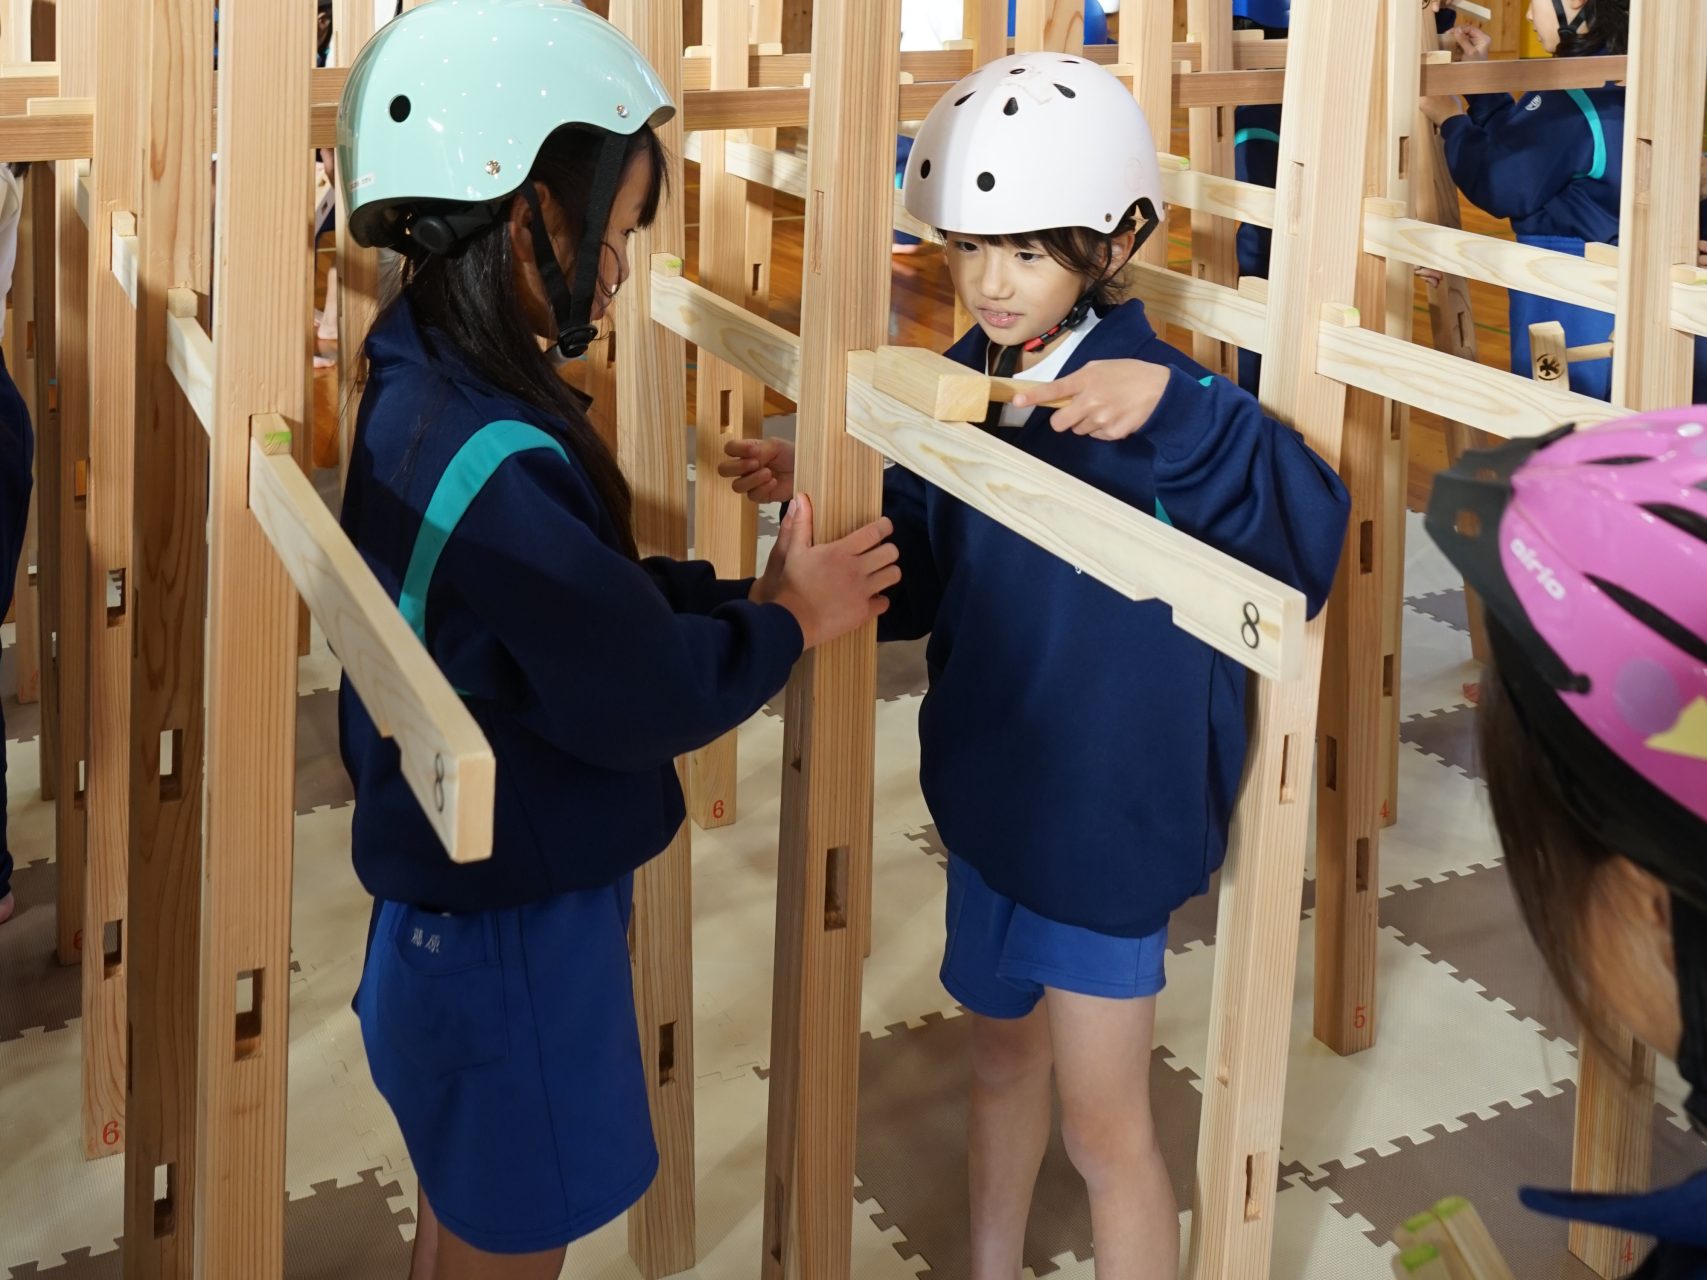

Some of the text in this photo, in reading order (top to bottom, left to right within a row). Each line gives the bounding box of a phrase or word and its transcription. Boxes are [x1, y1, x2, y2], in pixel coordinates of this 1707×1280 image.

[1240, 601, 1261, 650] 8
[433, 751, 446, 815] 8
[712, 799, 725, 819] 6
[1379, 798, 1392, 819] 4
[1353, 1005, 1366, 1029] 5
[102, 1119, 120, 1146] 6
[1621, 1233, 1633, 1264] 4
